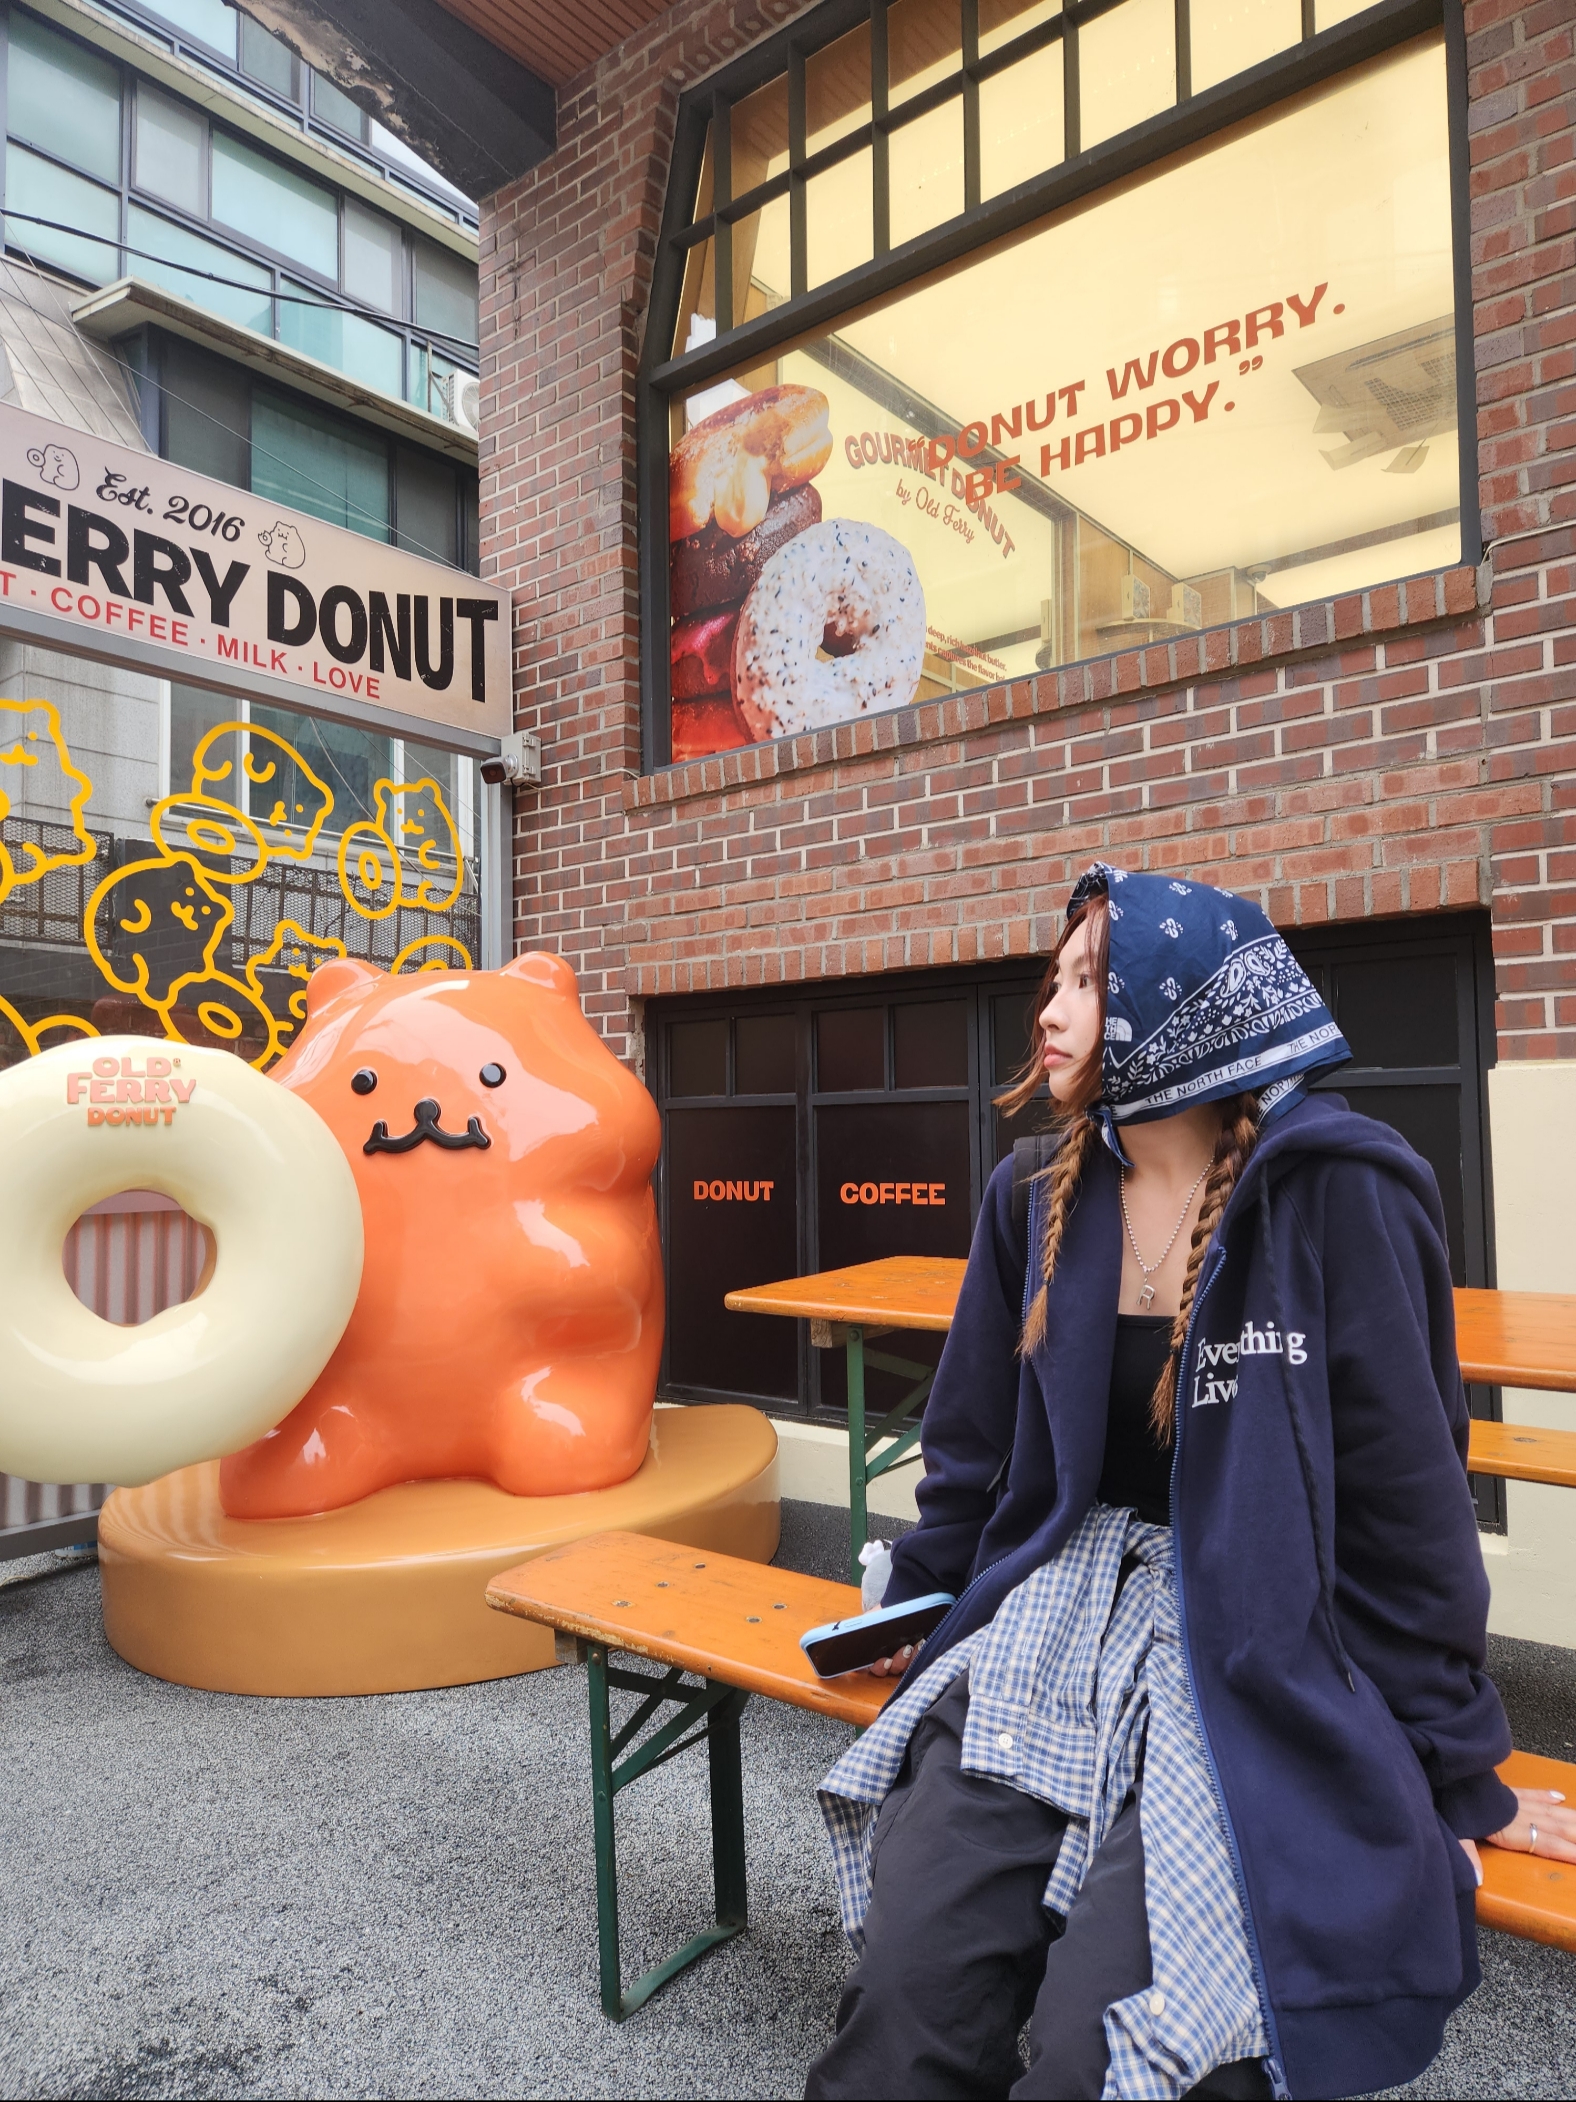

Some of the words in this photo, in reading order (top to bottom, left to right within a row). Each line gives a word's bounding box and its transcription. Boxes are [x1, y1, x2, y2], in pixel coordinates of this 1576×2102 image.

[1107, 283, 1345, 399] WORRY.
[965, 455, 1022, 505] BE
[96, 466, 153, 515] Est.
[162, 495, 245, 542] 2016
[896, 478, 911, 506] by
[916, 486, 940, 519] Old
[943, 504, 975, 544] Ferry
[51, 586, 188, 647] COFFEE
[217, 633, 288, 674] MILK
[313, 661, 381, 700] LOVE
[267, 570, 499, 704] DONUT
[927, 625, 947, 644] deep,
[966, 659, 977, 672] the
[977, 663, 995, 680] flavor
[1287, 1037, 1308, 1054] THE
[67, 1072, 196, 1104] FERRY
[1145, 1088, 1174, 1105] THE
[1177, 1069, 1224, 1097] NORTH
[1227, 1055, 1262, 1077] FACE
[87, 1106, 177, 1126] DONUT
[693, 1180, 774, 1202] DONUT
[840, 1182, 946, 1205] COFFEE
